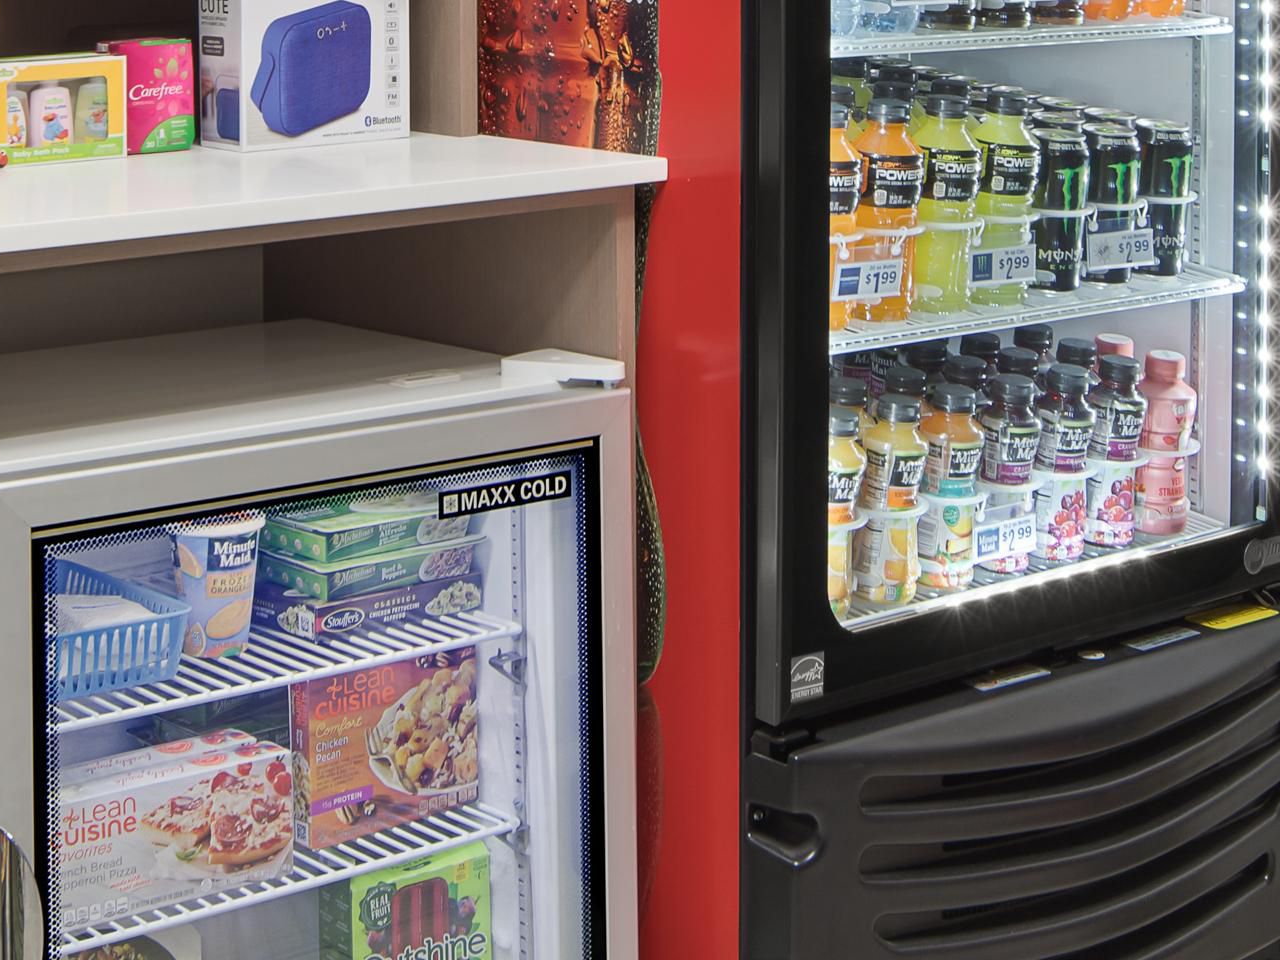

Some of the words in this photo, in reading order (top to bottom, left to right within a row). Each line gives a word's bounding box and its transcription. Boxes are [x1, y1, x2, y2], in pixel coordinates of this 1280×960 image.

[128, 83, 183, 101] Carefree
[373, 115, 401, 127] Bluetooth
[460, 480, 516, 512] MAXX
[520, 476, 569, 503] COLD
[315, 749, 342, 764] Pecan
[333, 790, 363, 807] PROTEIN
[370, 904, 392, 920] FRUIT
